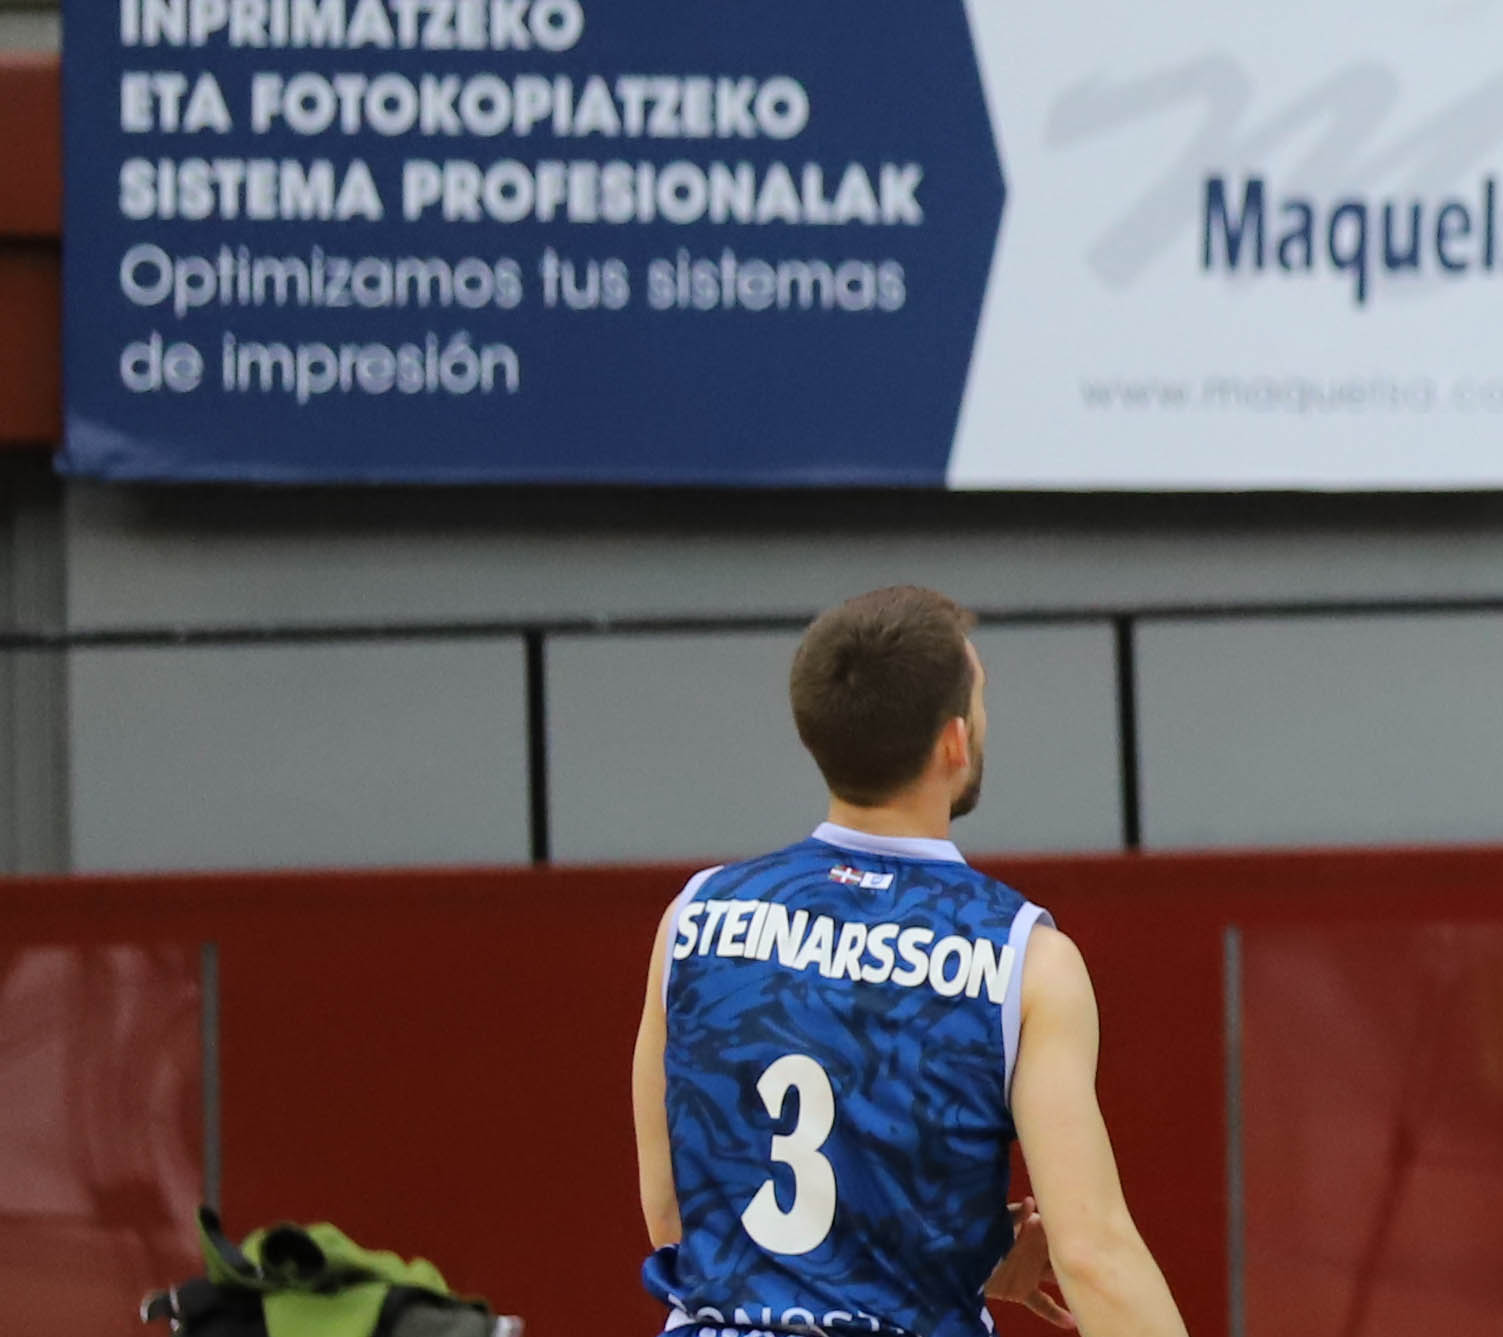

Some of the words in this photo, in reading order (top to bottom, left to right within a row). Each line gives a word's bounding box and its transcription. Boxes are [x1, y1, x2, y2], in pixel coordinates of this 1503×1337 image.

[119, 72, 232, 135] ETA
[250, 74, 811, 139] FOTOKOPIATZEKO
[119, 159, 383, 222] SISTEMA
[402, 162, 924, 226] PROFESIONALAK
[119, 243, 522, 319] Optimizamos
[541, 248, 629, 310] tus
[648, 247, 906, 312] sistemas
[119, 333, 202, 394] de
[223, 330, 519, 405] impresión
[672, 899, 1015, 1005] STEINARSSON
[741, 1054, 838, 1255] 3
